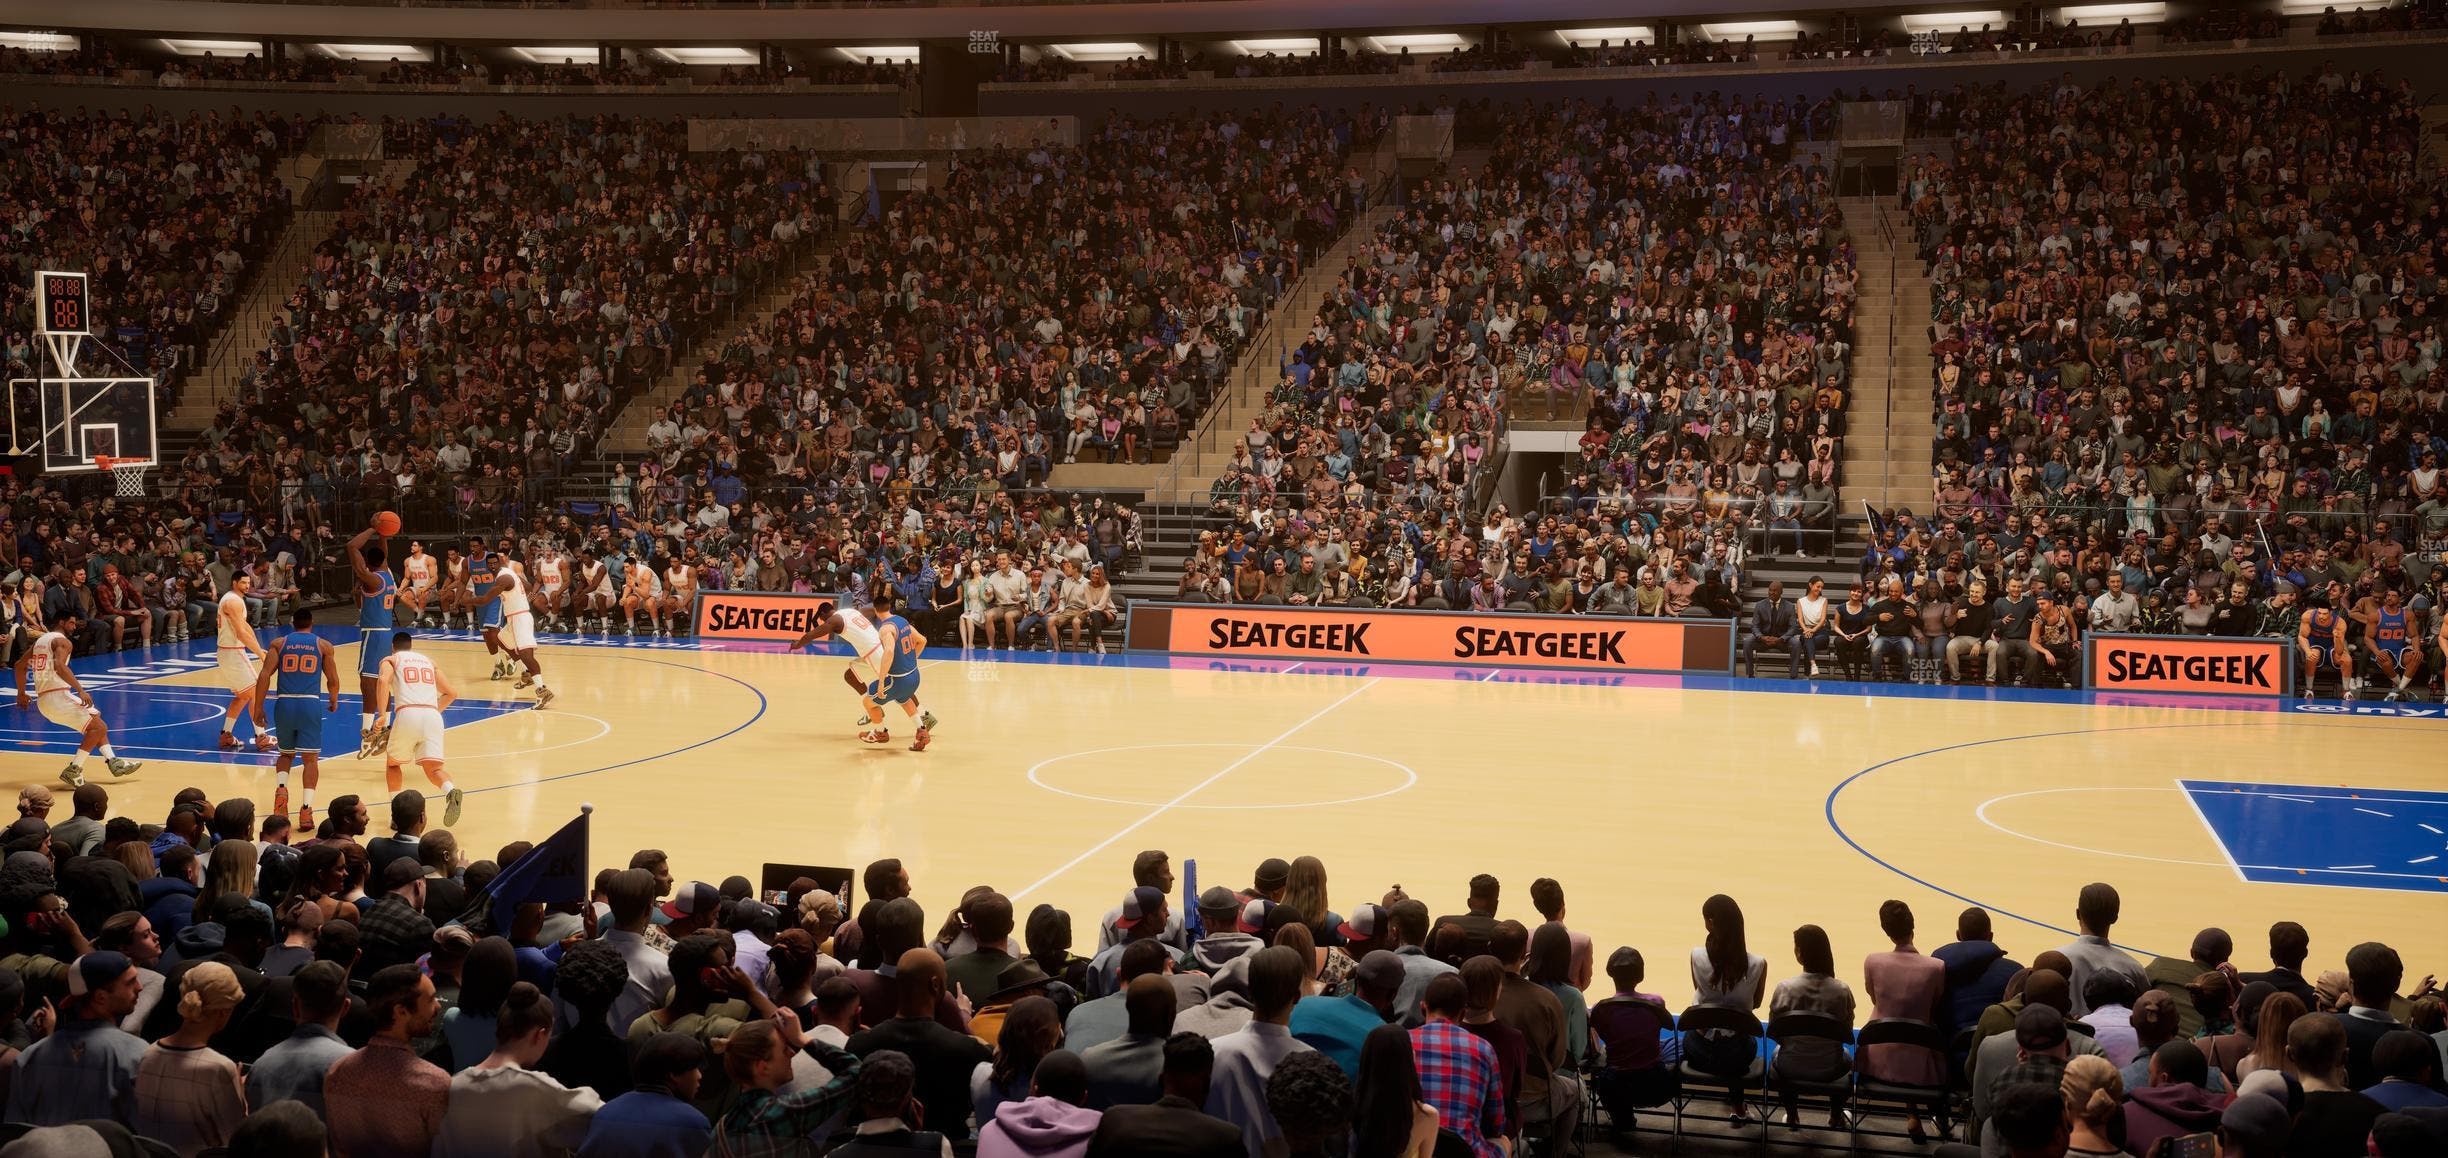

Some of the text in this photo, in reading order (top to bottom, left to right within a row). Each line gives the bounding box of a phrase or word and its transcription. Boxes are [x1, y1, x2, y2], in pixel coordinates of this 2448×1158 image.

[54, 299, 79, 328] 88
[1209, 618, 1626, 664] SEATGEEK SEATGEEK
[2379, 629, 2404, 641] 00
[282, 653, 318, 674] 00
[403, 666, 435, 685] 00
[2107, 649, 2271, 688] SEATGEEK
